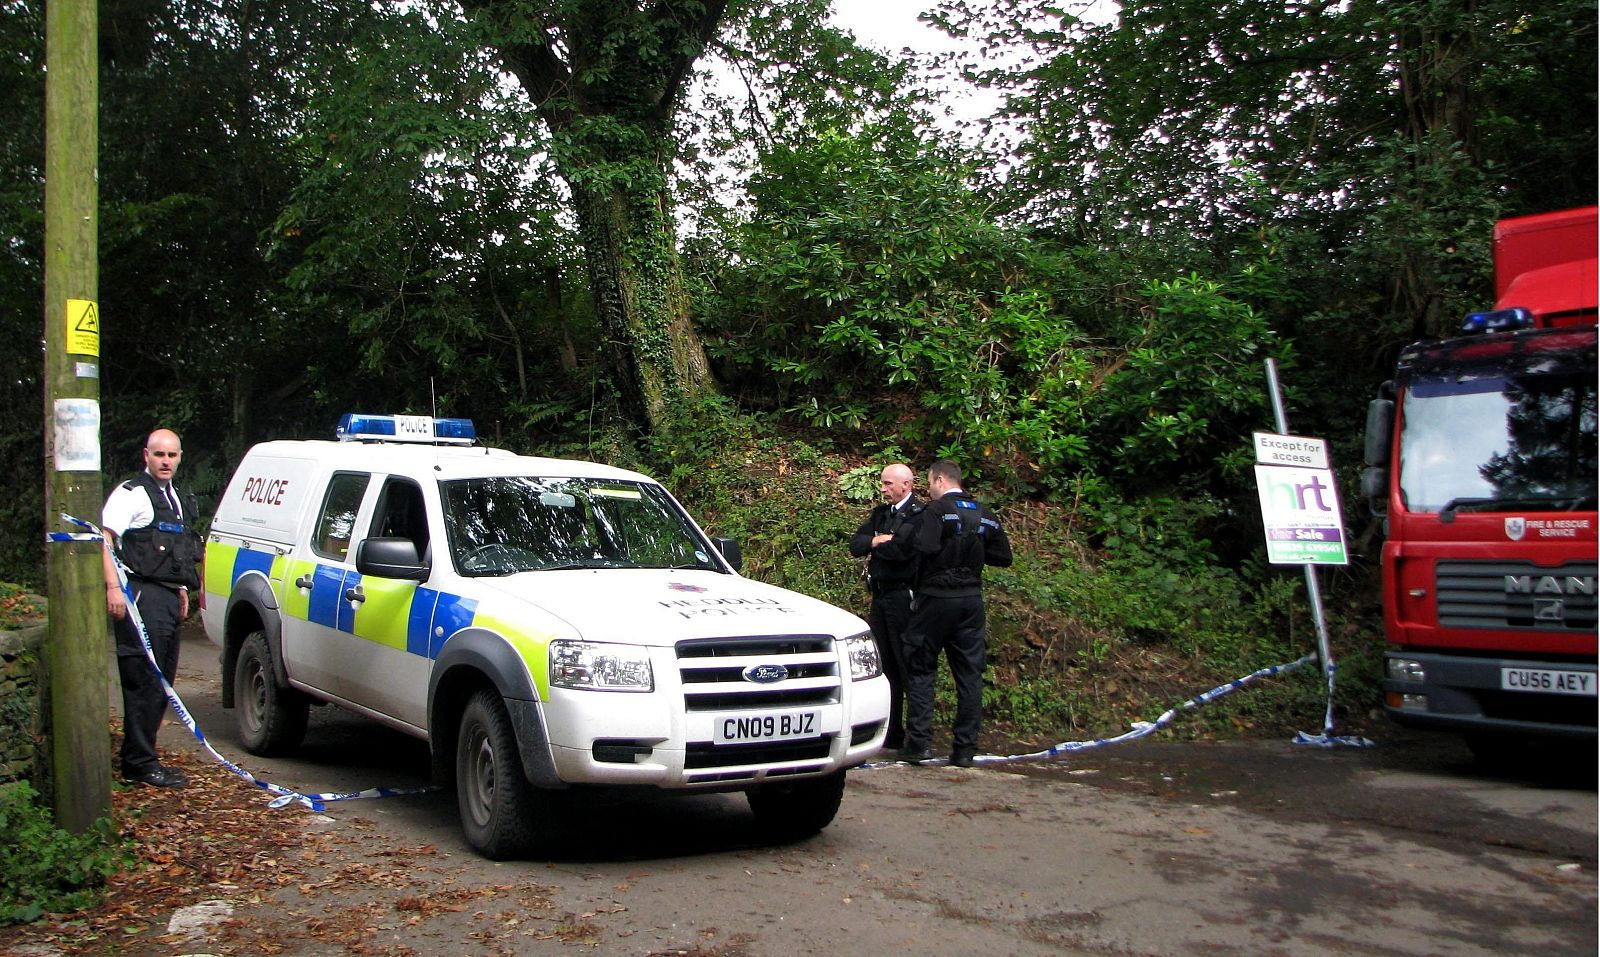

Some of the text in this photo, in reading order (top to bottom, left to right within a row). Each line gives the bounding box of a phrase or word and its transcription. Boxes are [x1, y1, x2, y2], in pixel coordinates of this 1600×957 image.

[400, 416, 428, 434] POLICE
[1260, 437, 1320, 453] Except for
[1272, 452, 1312, 463] access
[241, 477, 289, 506] POLICE
[1265, 474, 1332, 511] hrt
[1526, 519, 1589, 529] FIRE & RESCUE
[1539, 528, 1576, 537] SERVICE
[1295, 529, 1324, 540] Sale
[1504, 575, 1594, 594] MAN
[756, 667, 779, 679] Ford
[1508, 670, 1589, 691] CU56 AEY
[723, 713, 814, 740] CN09 BJZ
